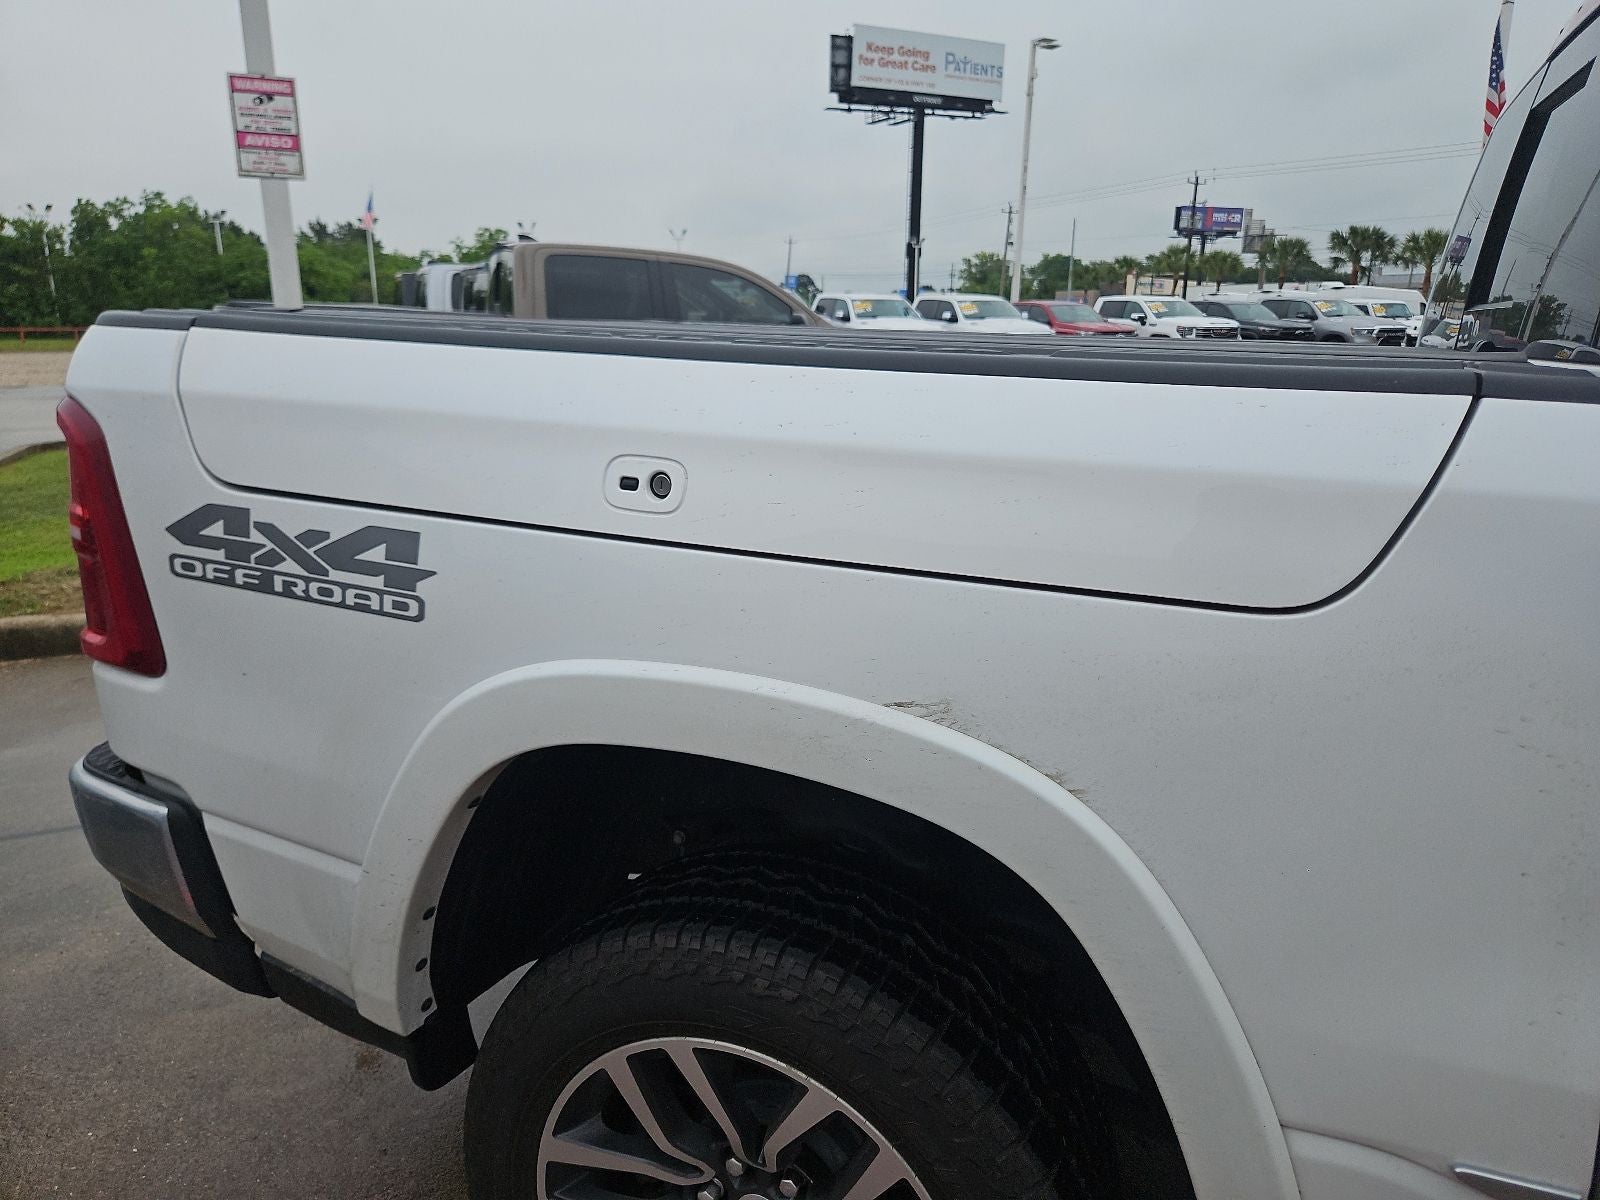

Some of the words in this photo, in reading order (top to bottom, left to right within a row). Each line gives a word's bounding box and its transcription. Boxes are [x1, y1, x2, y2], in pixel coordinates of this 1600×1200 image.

[866, 41, 894, 56] Keep
[897, 46, 930, 61] Going
[858, 54, 875, 67] for
[878, 57, 909, 70] Great
[911, 61, 937, 74] Care
[944, 52, 1003, 79] PATIENTS
[173, 557, 263, 586] OFF
[273, 574, 419, 617] ROAD
